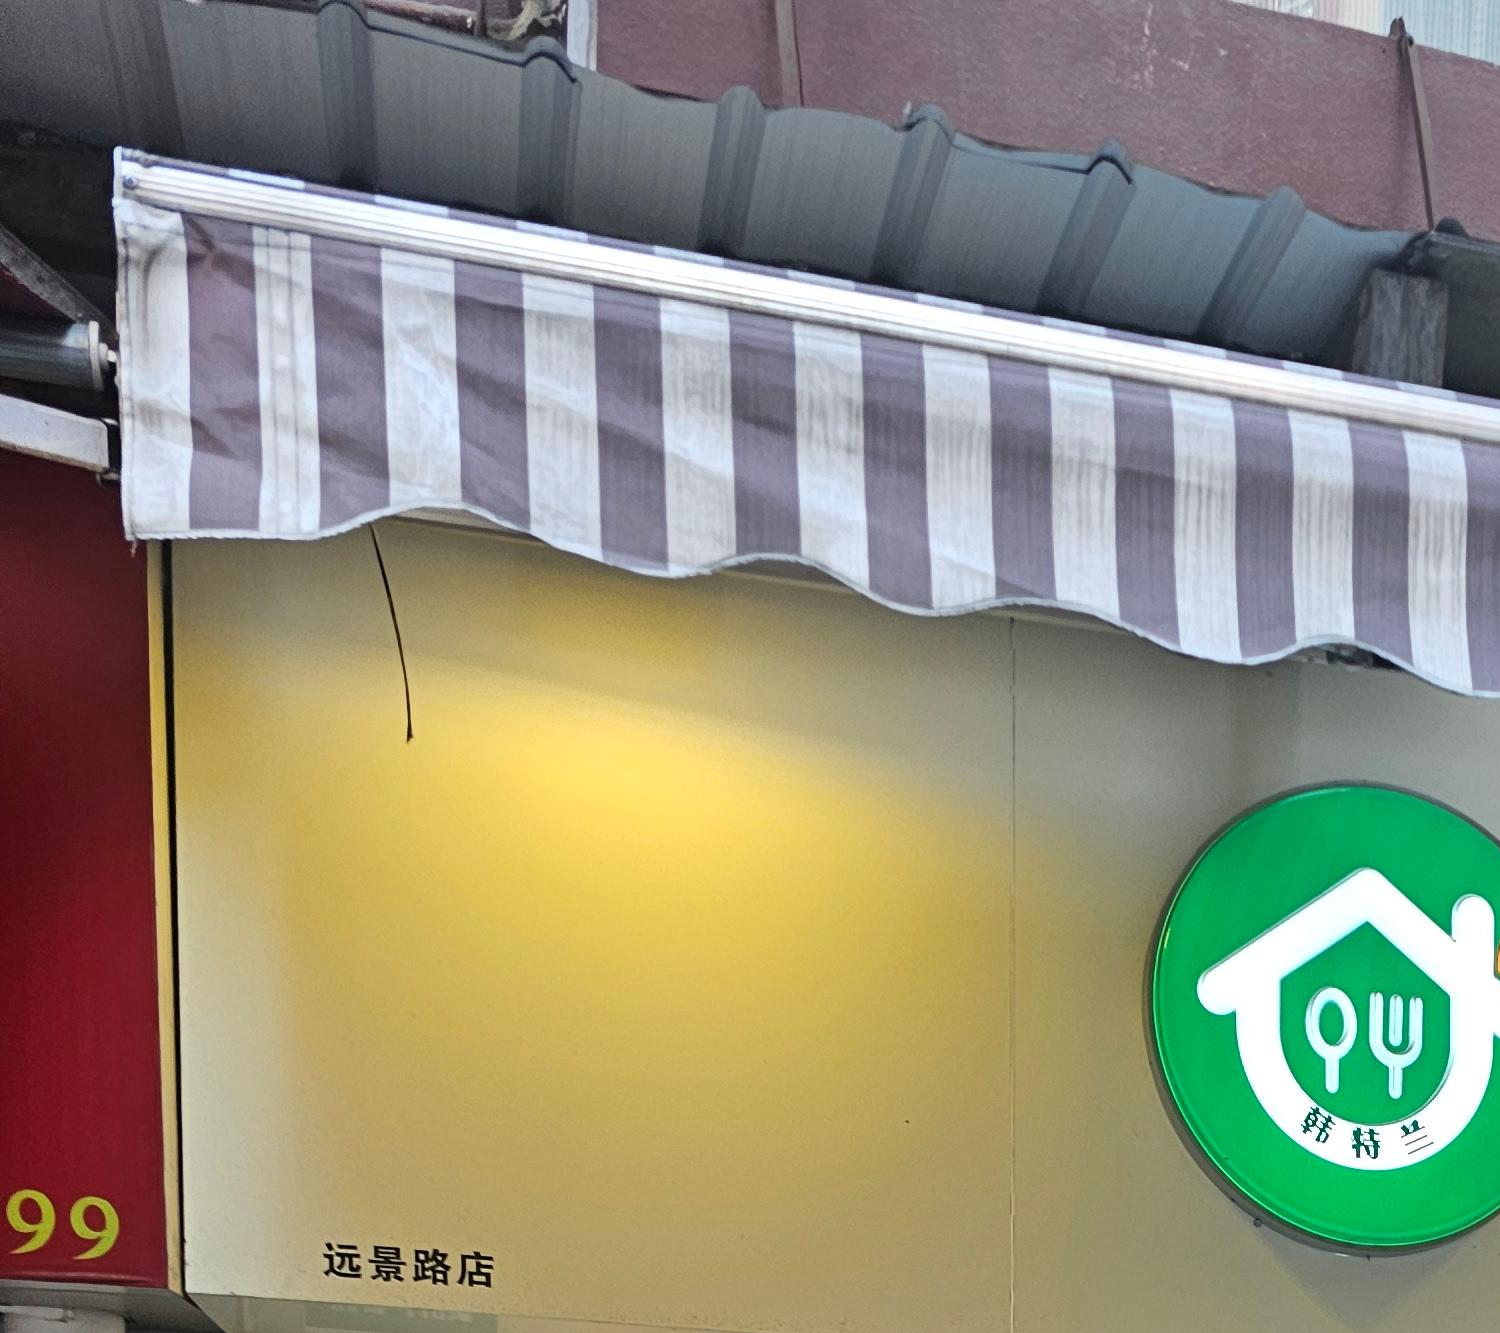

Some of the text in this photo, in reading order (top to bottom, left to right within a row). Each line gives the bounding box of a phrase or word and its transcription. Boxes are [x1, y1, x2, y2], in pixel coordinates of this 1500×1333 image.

[1300, 1106, 1434, 1160] 韩特兰
[6, 1188, 120, 1260] 99
[322, 1242, 496, 1288] 远景路店
